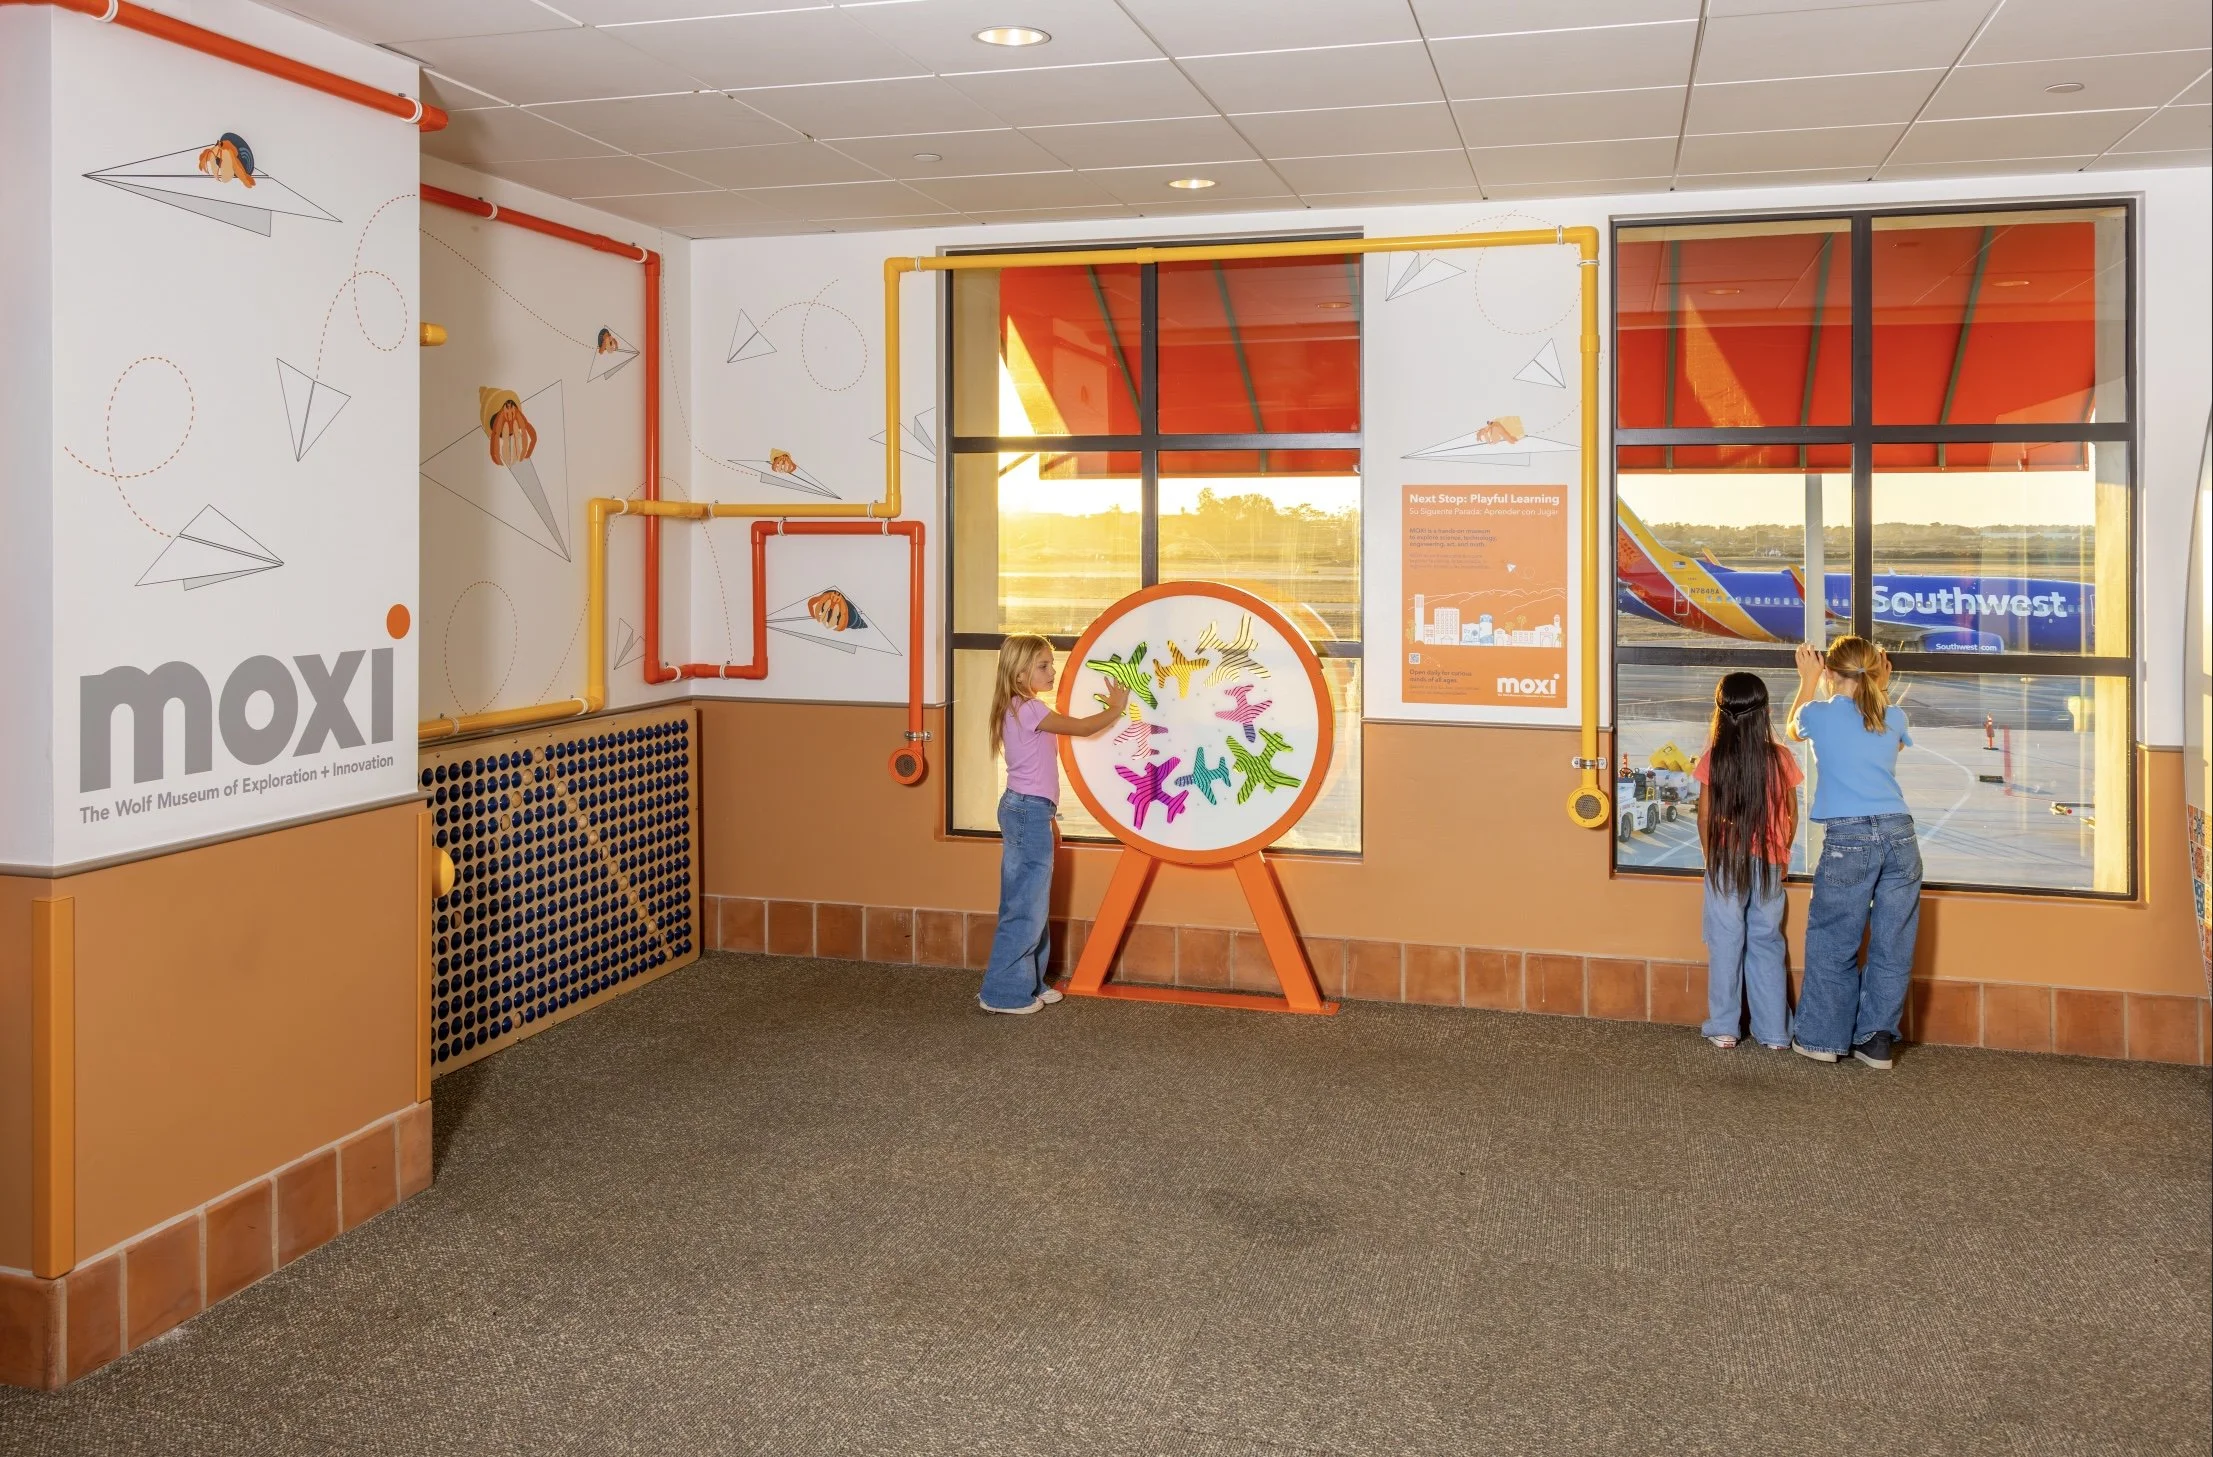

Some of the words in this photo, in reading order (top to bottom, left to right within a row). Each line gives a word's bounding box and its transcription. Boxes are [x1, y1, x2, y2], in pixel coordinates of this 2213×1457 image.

[1409, 493, 1436, 504] Next
[1438, 493, 1467, 506] Stop:
[1470, 493, 1508, 506] Playful
[1510, 493, 1560, 506] Learning
[1409, 507, 1419, 515] Su
[1454, 507, 1482, 515] Parada:
[1484, 507, 1519, 516] Aprender
[1537, 507, 1558, 517] Jugar
[1872, 585, 2068, 618] Southwest
[1496, 673, 1560, 695] moxi
[79, 603, 411, 794] moxi
[79, 806, 110, 824] The
[115, 795, 153, 817] Wolf
[157, 787, 220, 810] Museum
[223, 779, 239, 797] of
[242, 768, 318, 794] Exploration
[320, 766, 330, 778] +
[333, 755, 394, 776] Innovation
